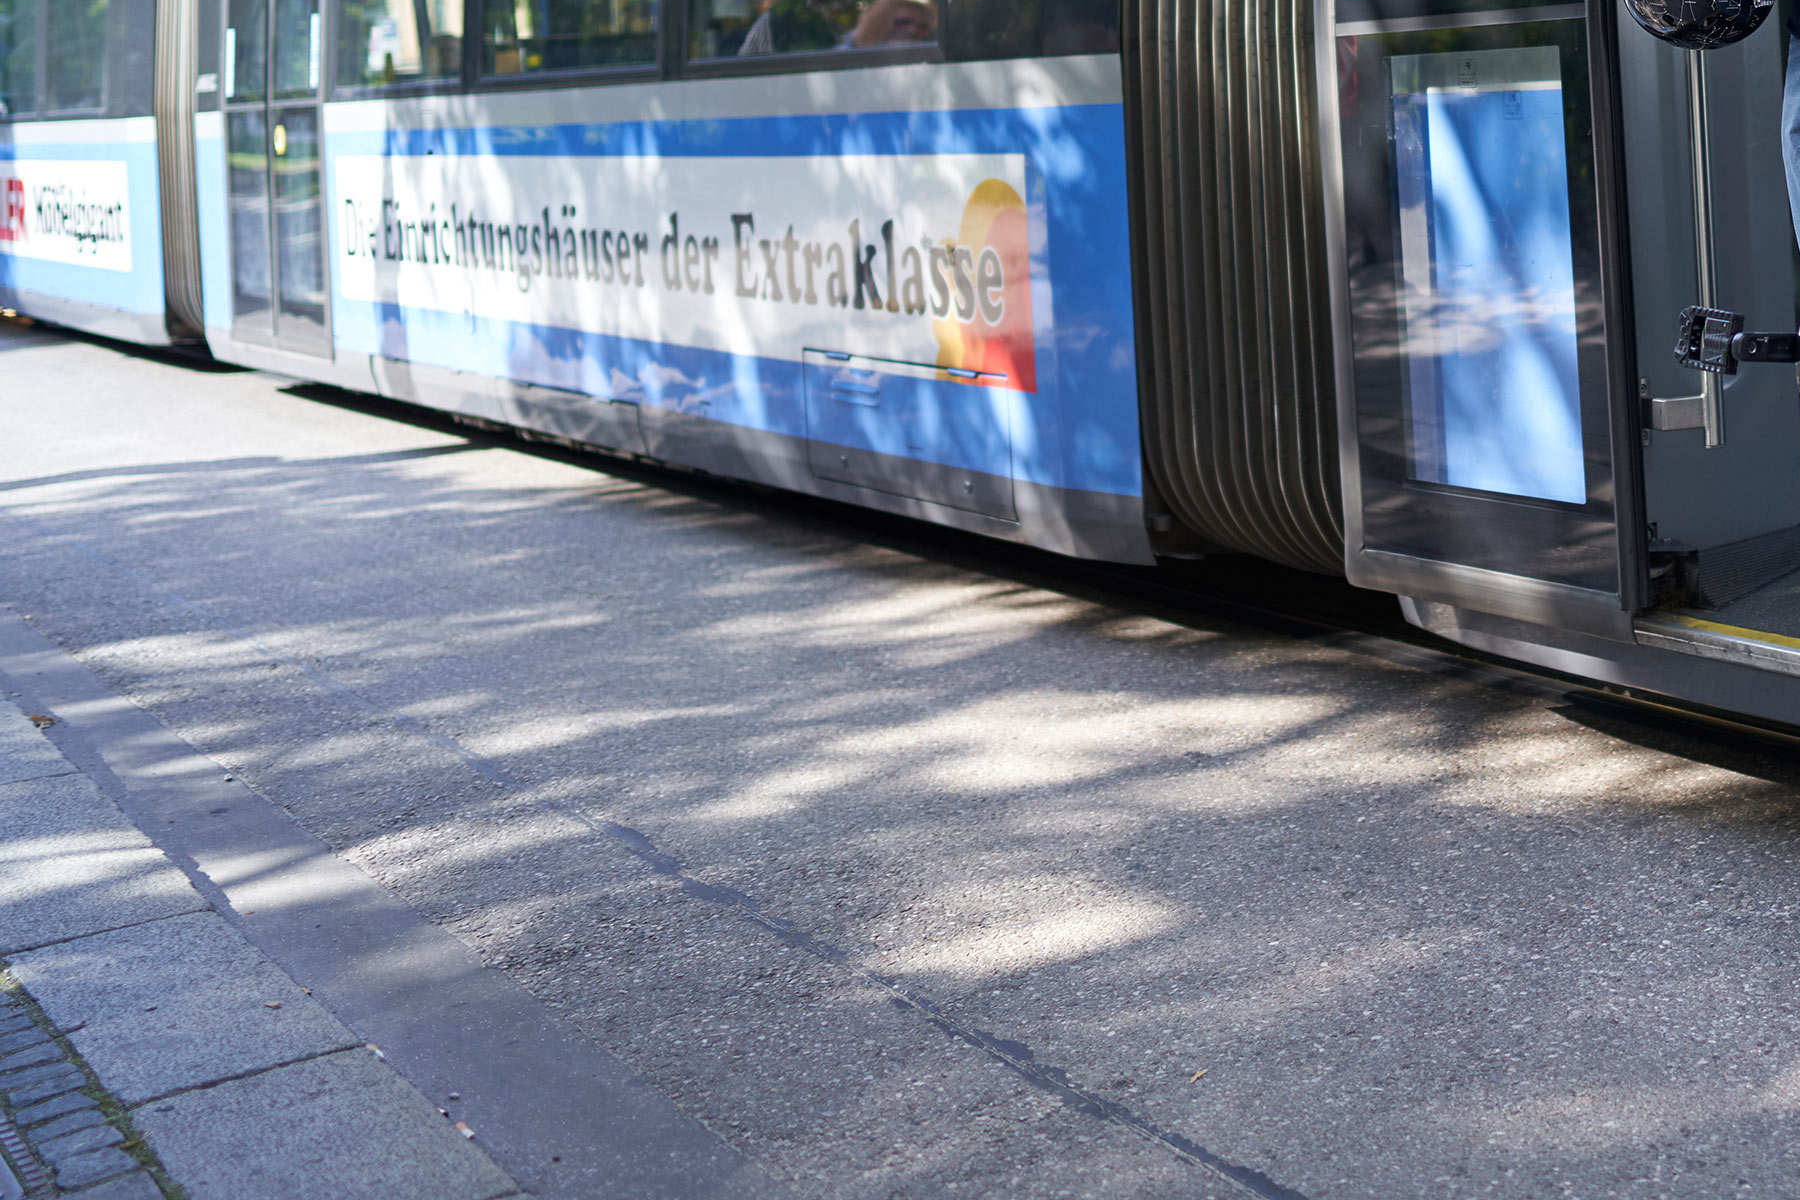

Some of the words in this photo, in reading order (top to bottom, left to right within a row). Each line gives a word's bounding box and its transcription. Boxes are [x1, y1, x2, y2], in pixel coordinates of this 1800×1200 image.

[382, 198, 648, 293] Einrichtungshäuser
[660, 211, 720, 296] der
[730, 212, 1005, 325] Extraklasse
